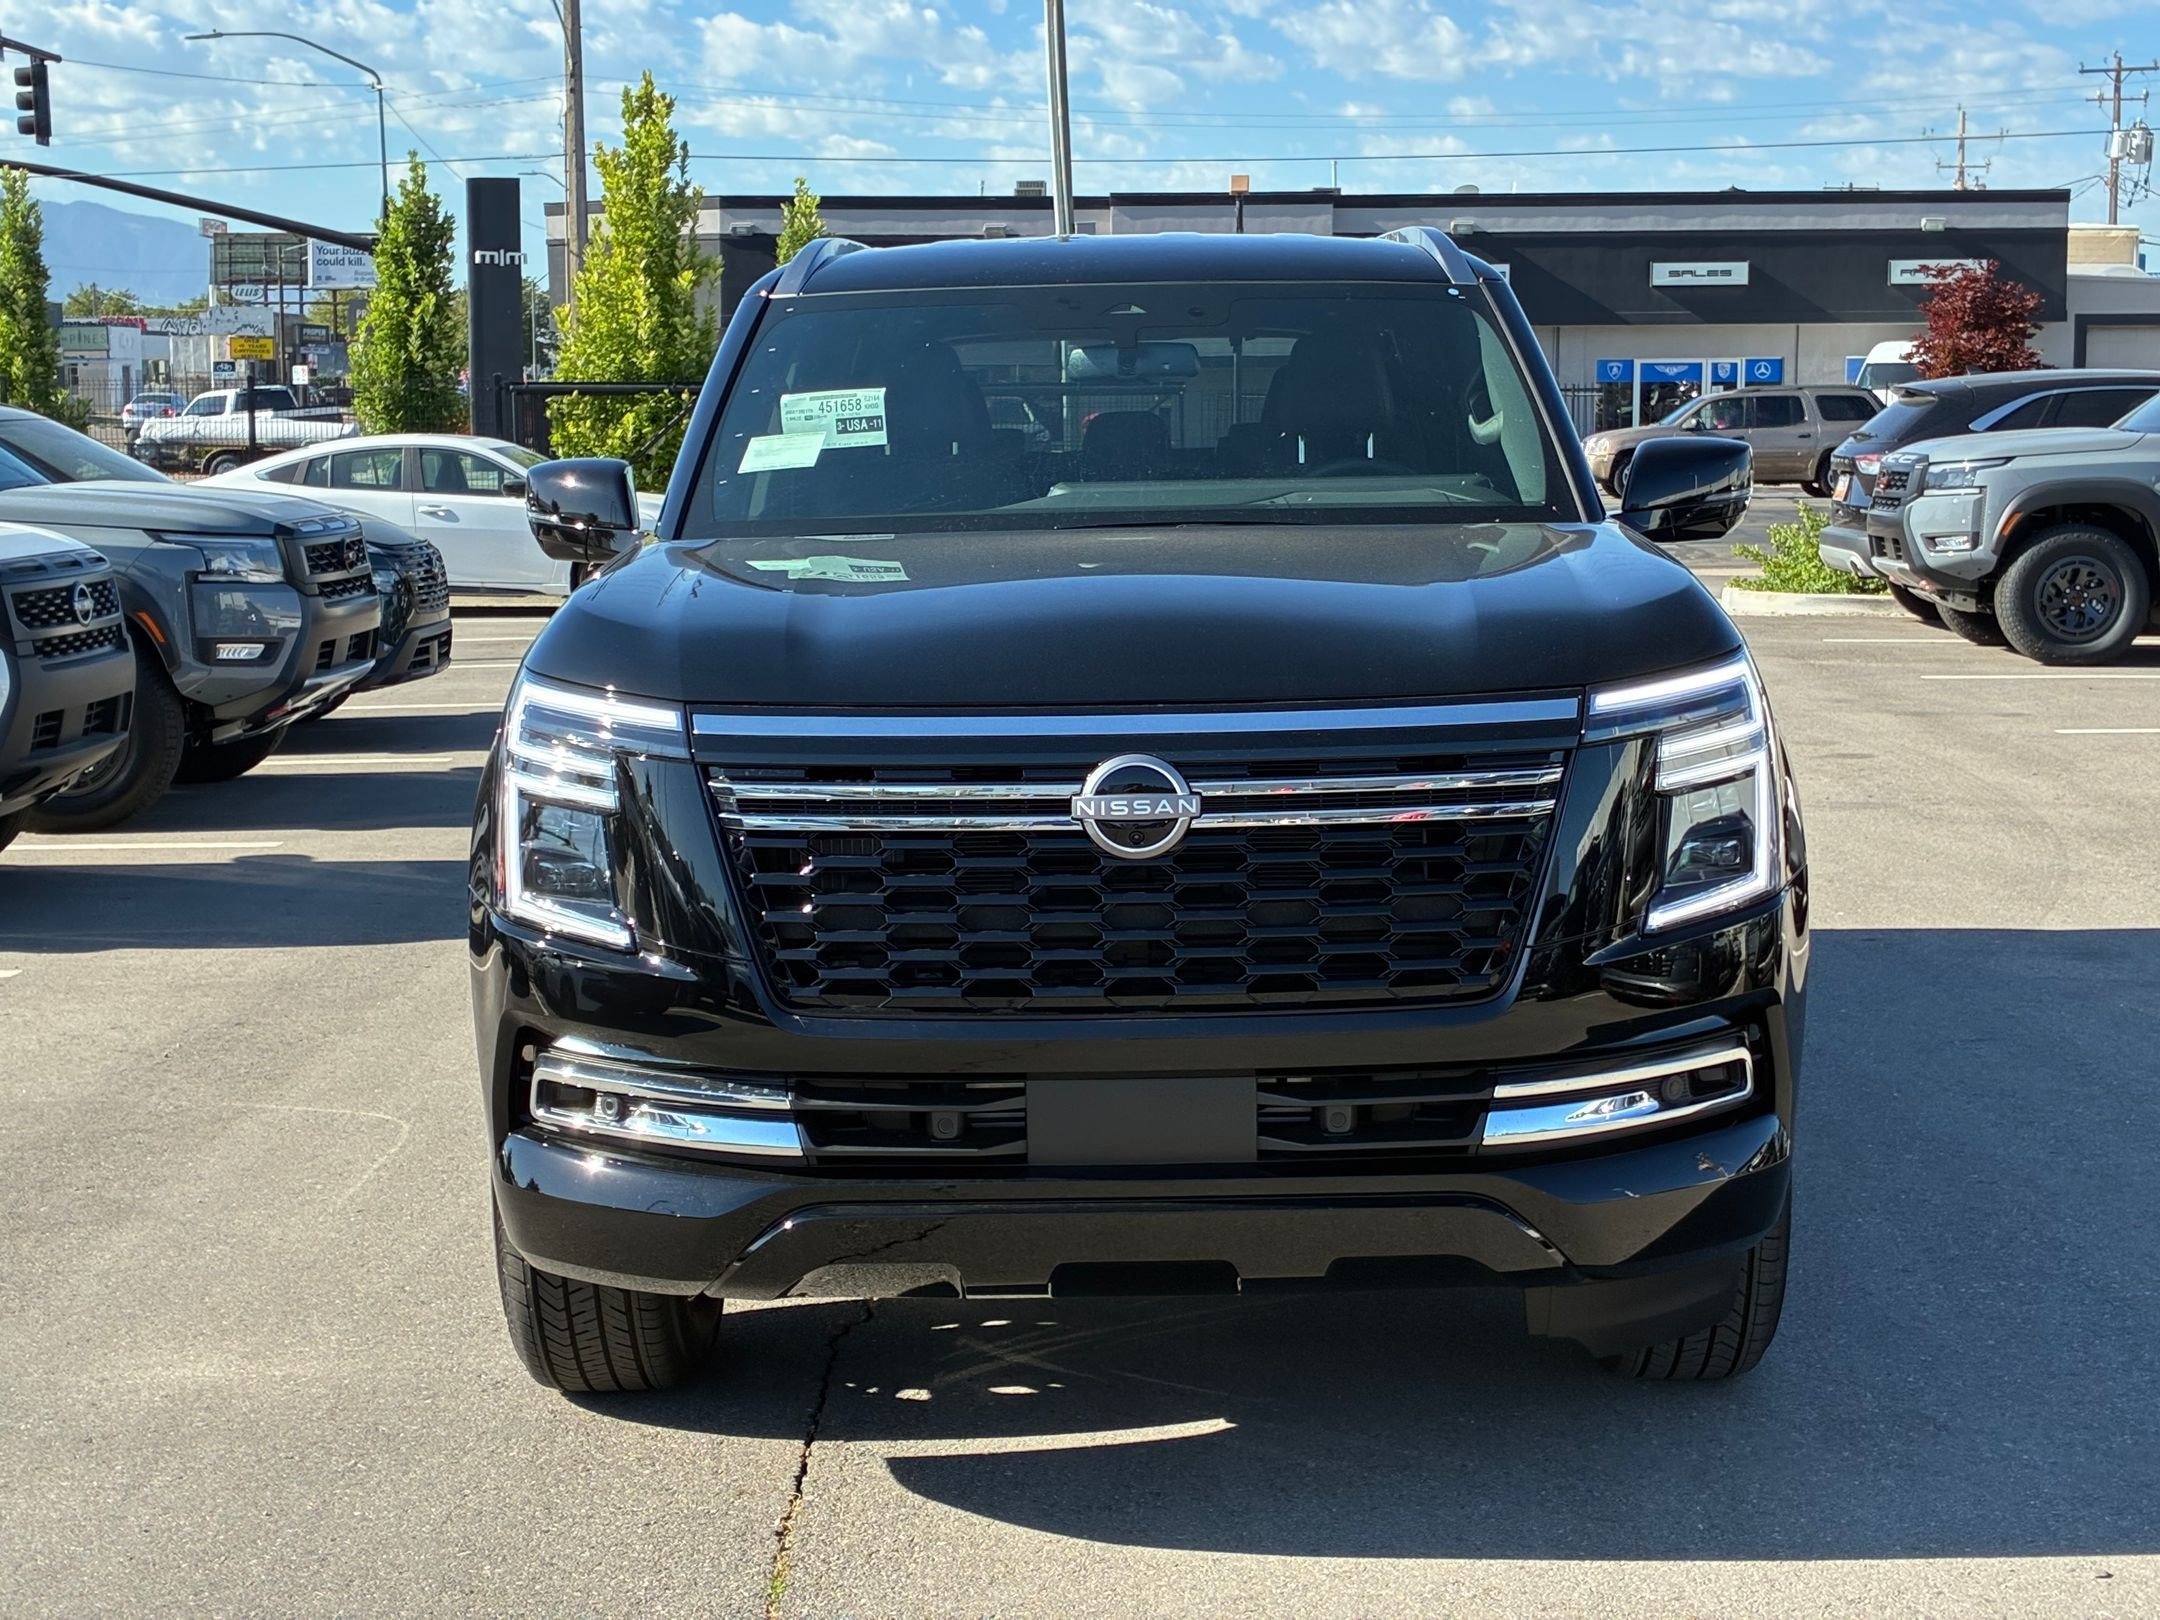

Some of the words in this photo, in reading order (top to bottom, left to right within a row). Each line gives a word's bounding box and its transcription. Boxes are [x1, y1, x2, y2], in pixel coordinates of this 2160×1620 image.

[316, 245, 340, 256] Your
[316, 256, 345, 266] could
[347, 256, 366, 266] kill.
[1668, 269, 1733, 278] SALES
[818, 398, 862, 414] 451658
[1076, 798, 1196, 816] NISSAN
